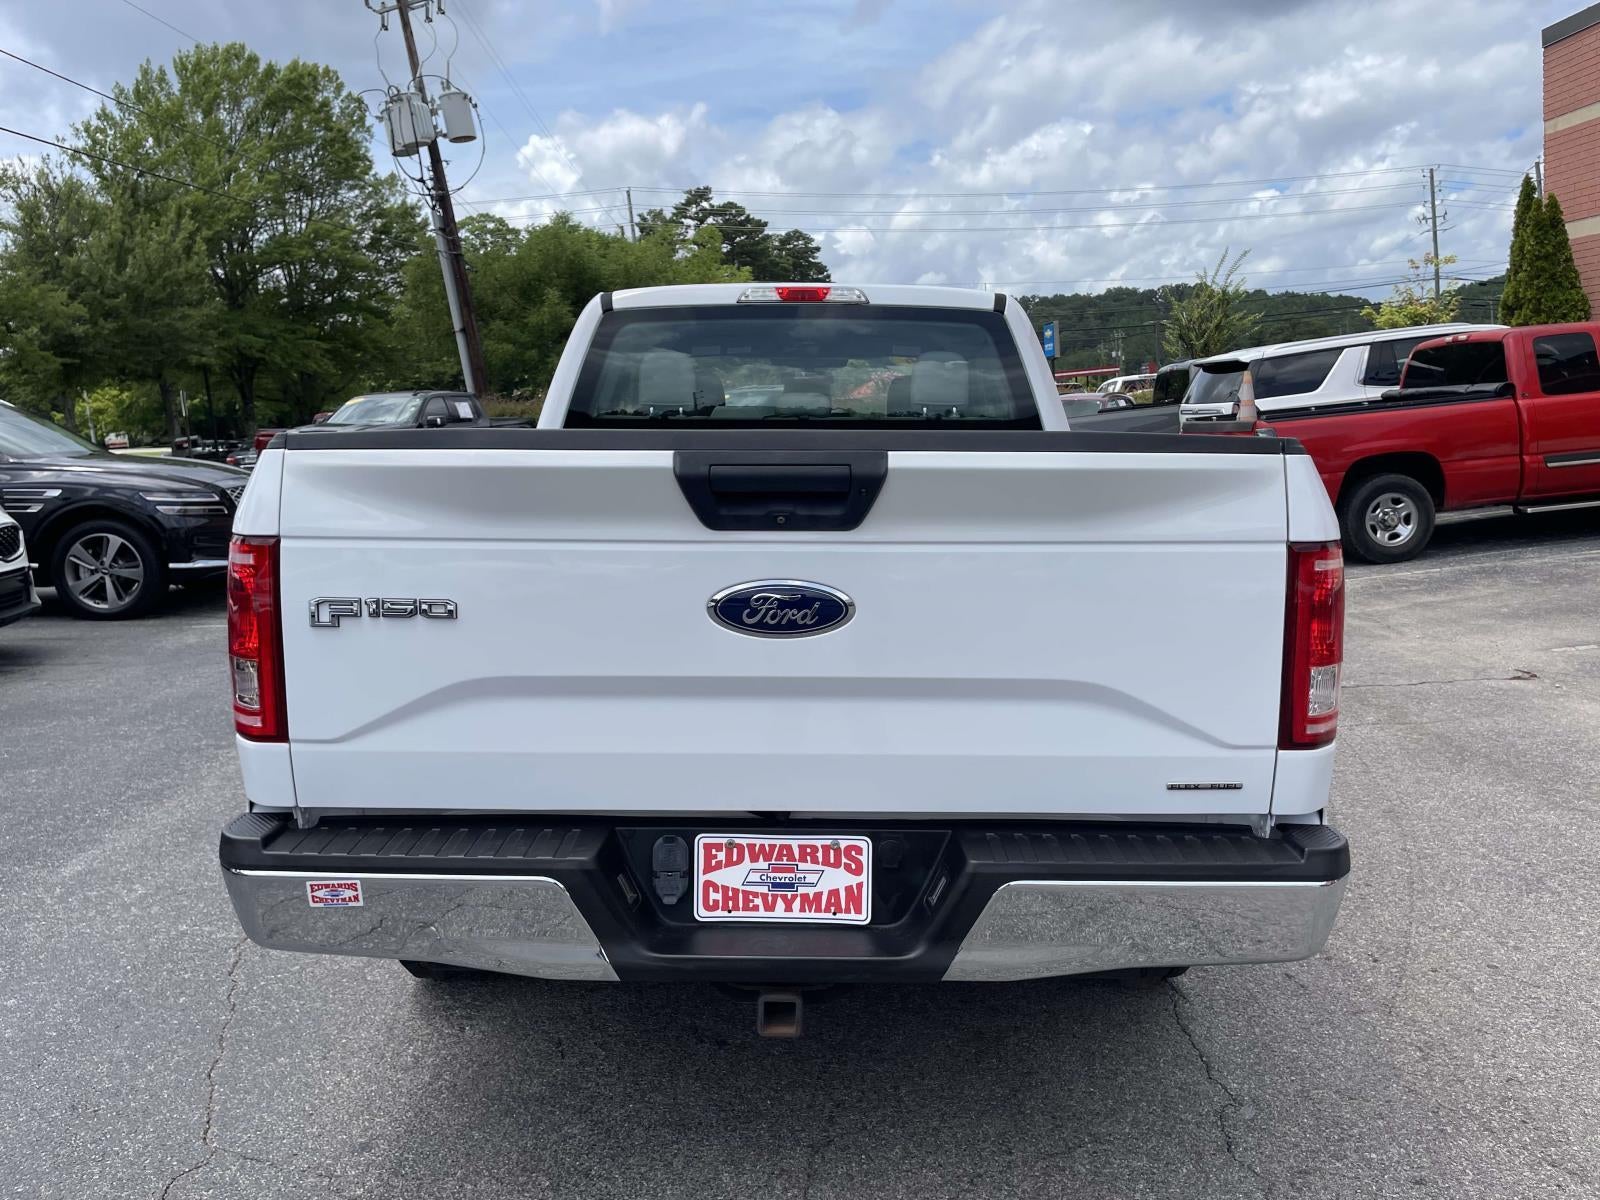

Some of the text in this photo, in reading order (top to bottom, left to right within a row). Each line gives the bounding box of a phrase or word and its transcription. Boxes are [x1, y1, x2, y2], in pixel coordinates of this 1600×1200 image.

[742, 593, 821, 625] Ford
[702, 842, 864, 877] EDWARDS
[310, 883, 358, 893] EDWARDS
[759, 873, 807, 882] Chevrolet
[311, 894, 360, 903] CHEVYMAN
[702, 879, 864, 915] CHEVYMAN
